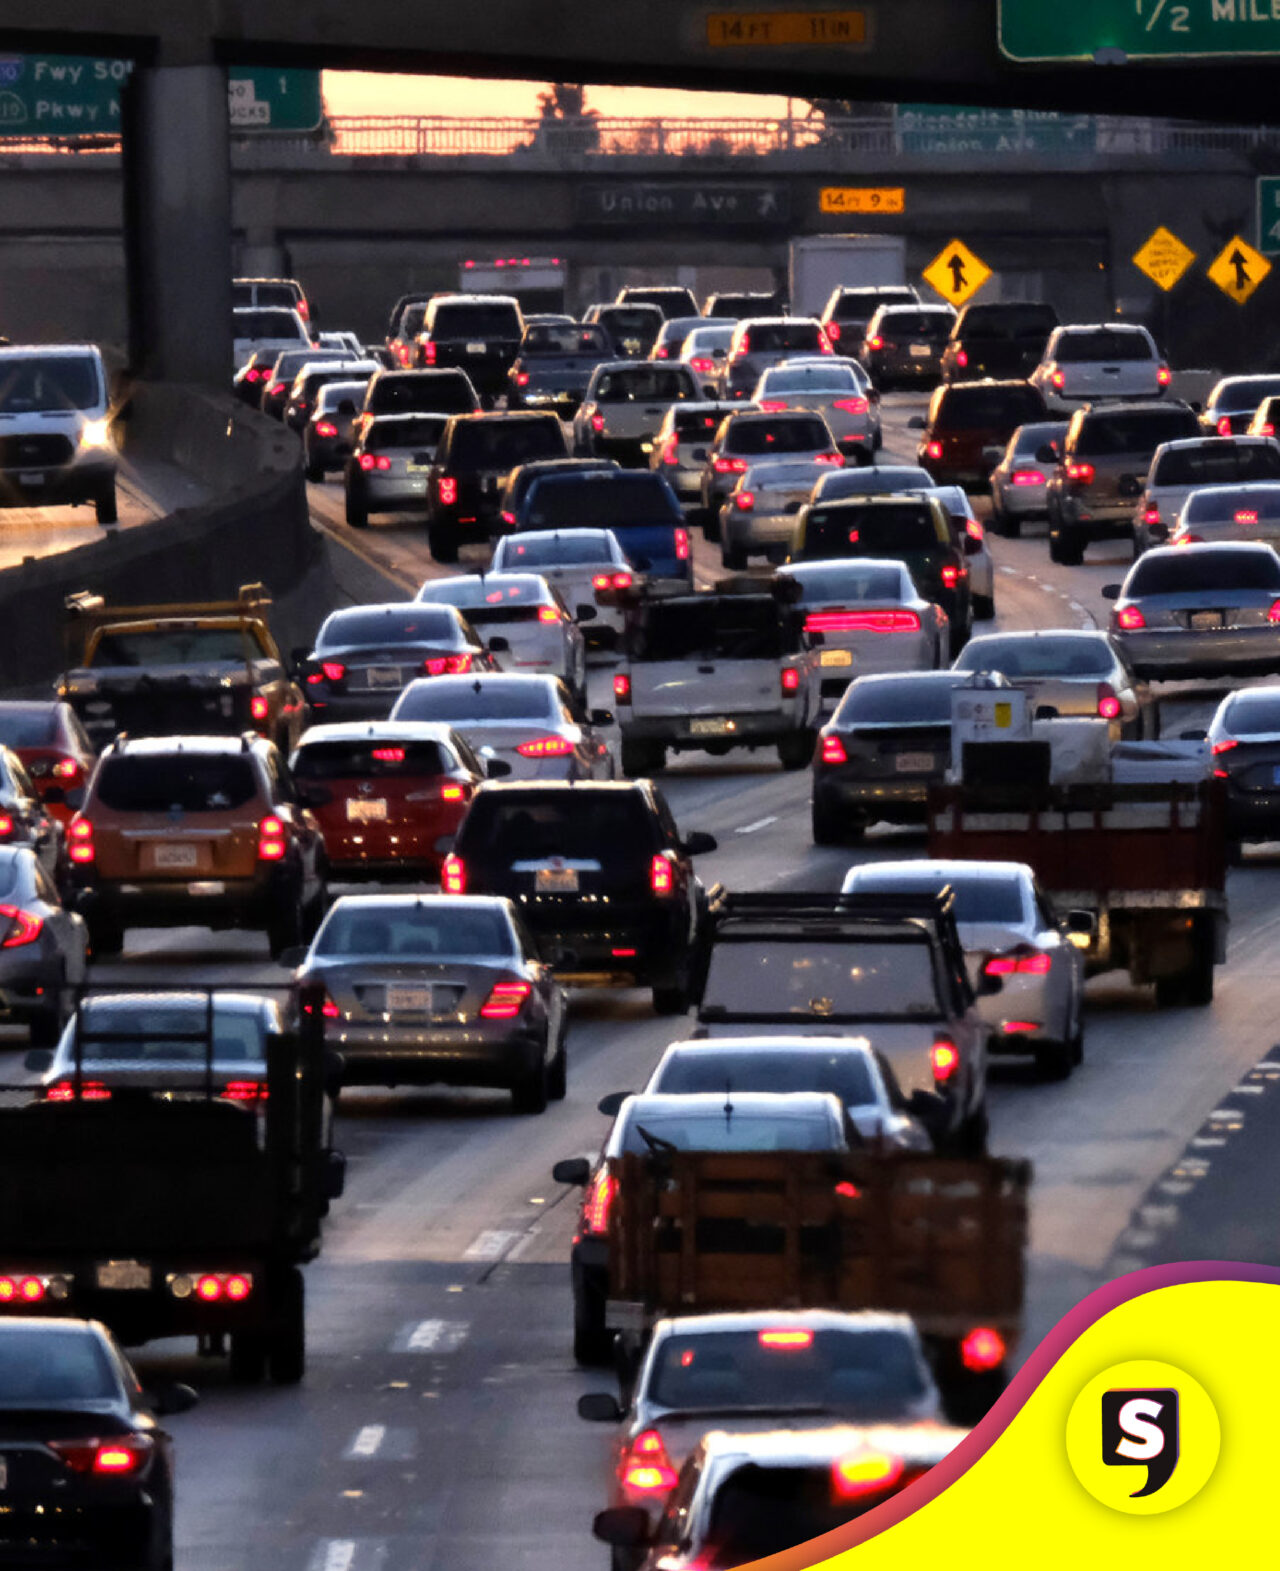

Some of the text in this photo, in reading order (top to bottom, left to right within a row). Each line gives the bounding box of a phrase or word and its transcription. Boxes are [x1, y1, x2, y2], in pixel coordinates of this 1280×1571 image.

[722, 20, 742, 40] 14
[749, 22, 772, 39] FT
[34, 61, 83, 84] Fwy
[36, 100, 98, 121] Pkwy
[601, 190, 738, 211] Union Ave
[826, 192, 845, 207] 14
[870, 193, 881, 208] 9
